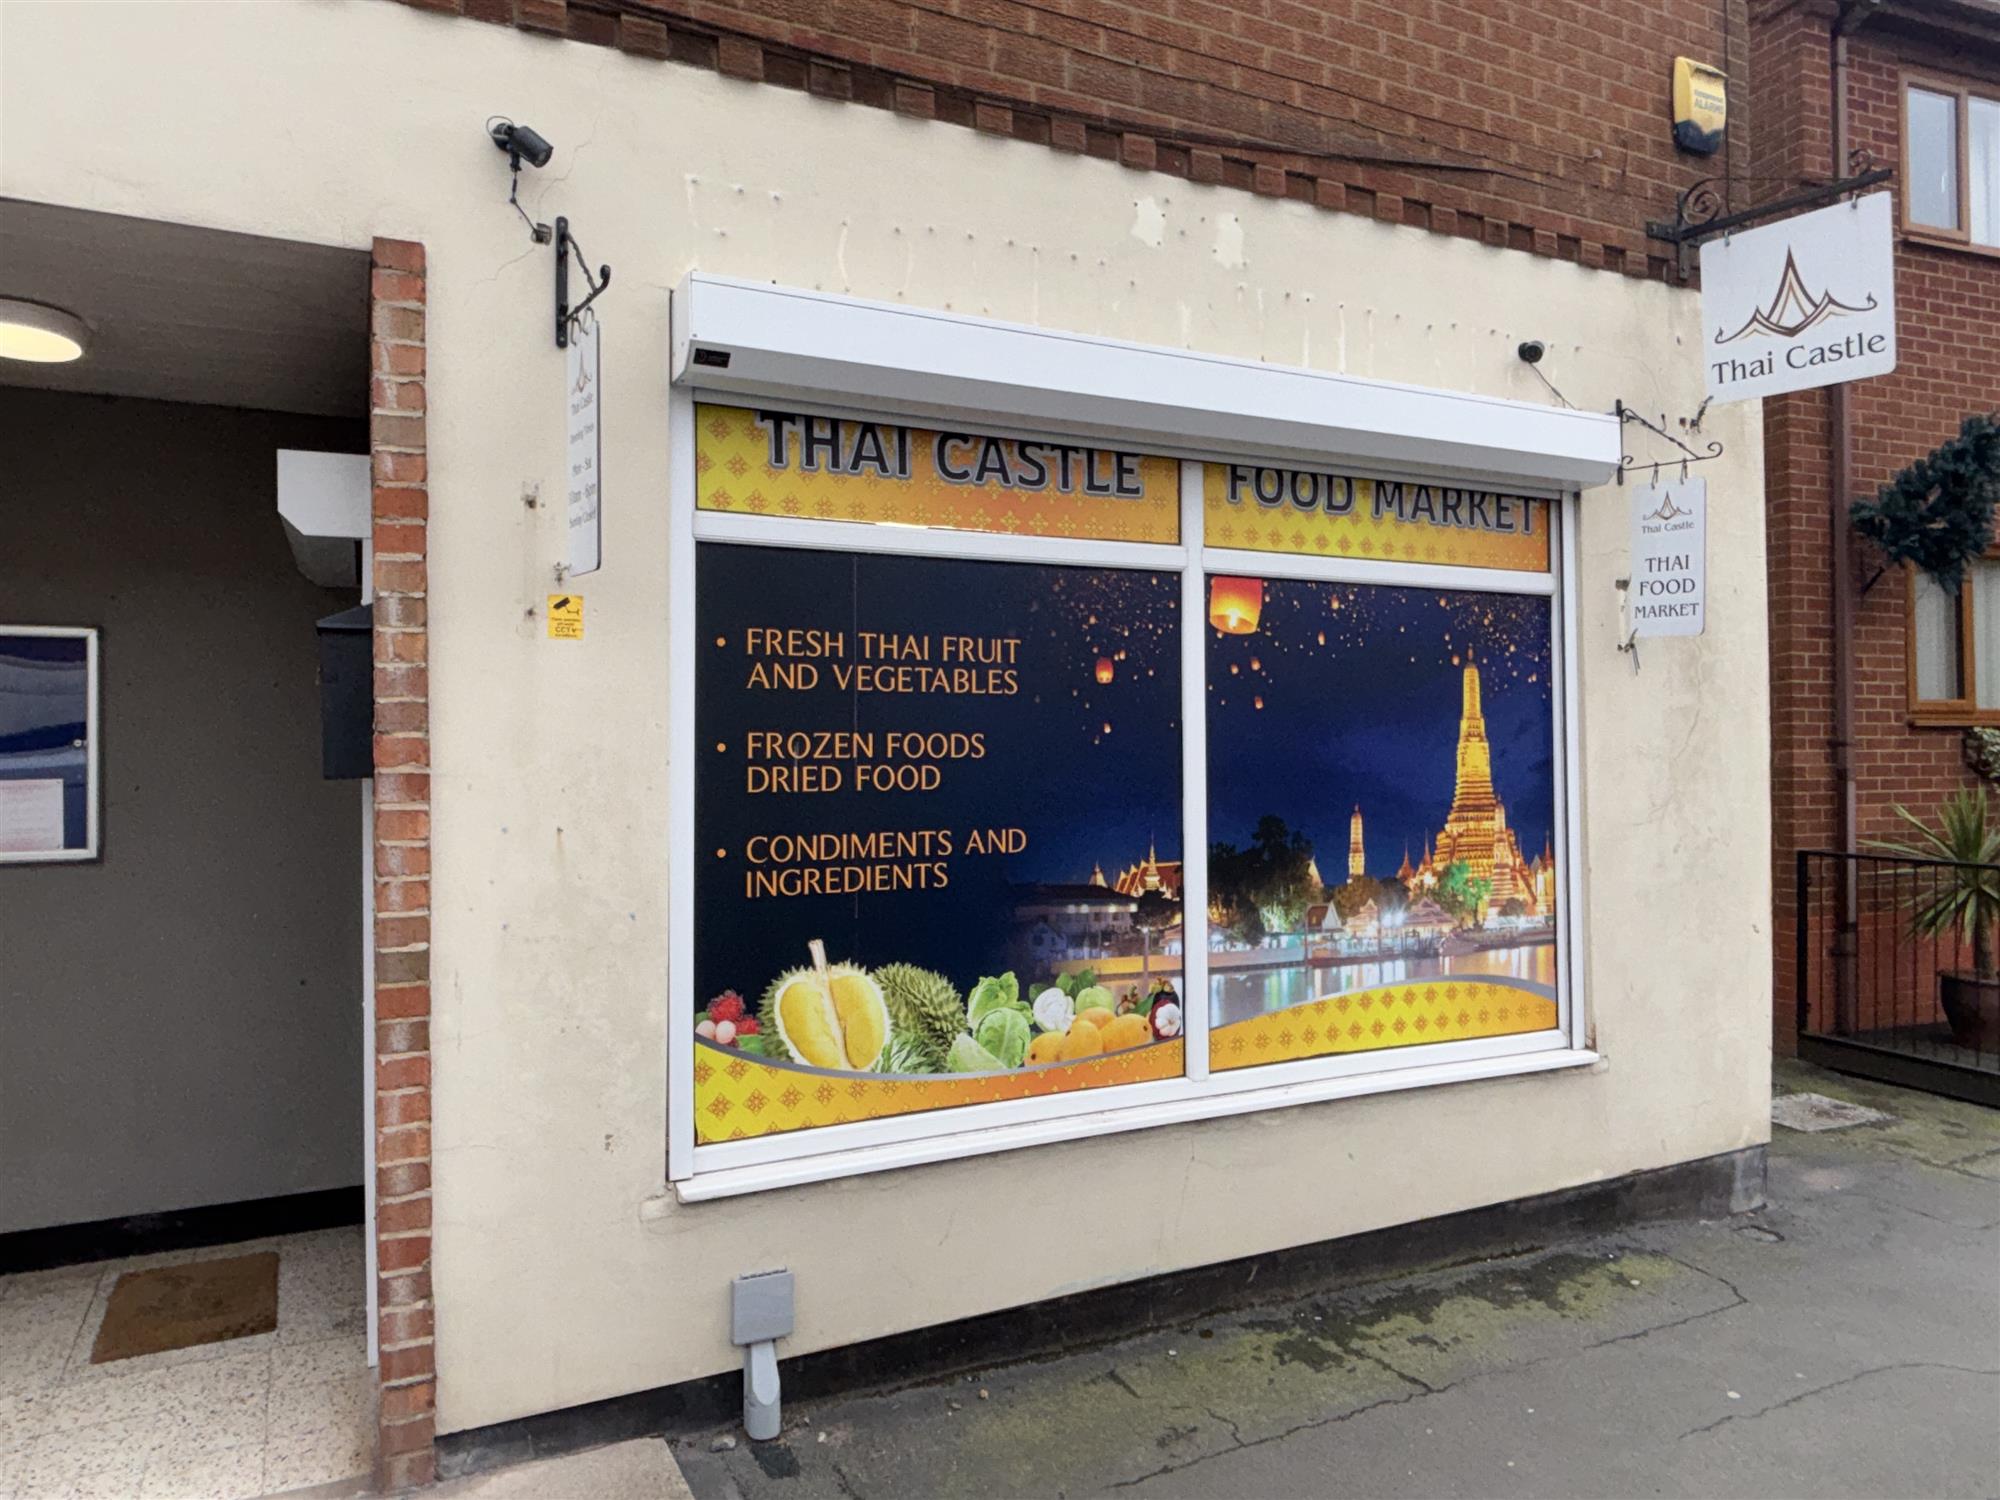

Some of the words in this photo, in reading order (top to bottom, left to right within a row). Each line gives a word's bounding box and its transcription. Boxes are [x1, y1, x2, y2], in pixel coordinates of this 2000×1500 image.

[1712, 351, 1774, 385] Thai
[1786, 332, 1887, 370] Castle
[758, 410, 912, 478] THAI
[936, 430, 1143, 497] CASTLE
[1226, 464, 1355, 516] FOOD
[1372, 479, 1541, 534] MARKET
[1641, 525, 1661, 535] Thai
[1664, 520, 1695, 532] Castle
[1645, 554, 1690, 573] THAI
[1639, 577, 1696, 597] FOOD
[1634, 602, 1700, 619] MARKET
[746, 628, 844, 658] FRESH
[858, 632, 929, 661] THAI
[942, 636, 1021, 664] FRUIT
[746, 662, 818, 690] AND
[832, 664, 1018, 695] VEGETABLES
[747, 732, 874, 759] FROZEN
[886, 732, 986, 759] FOODS
[747, 765, 842, 793] DRIED
[855, 765, 941, 791] FOOD
[746, 830, 952, 864] CONDIMENTS
[964, 828, 1027, 855] AND
[746, 862, 948, 898] INGREDIENTS
